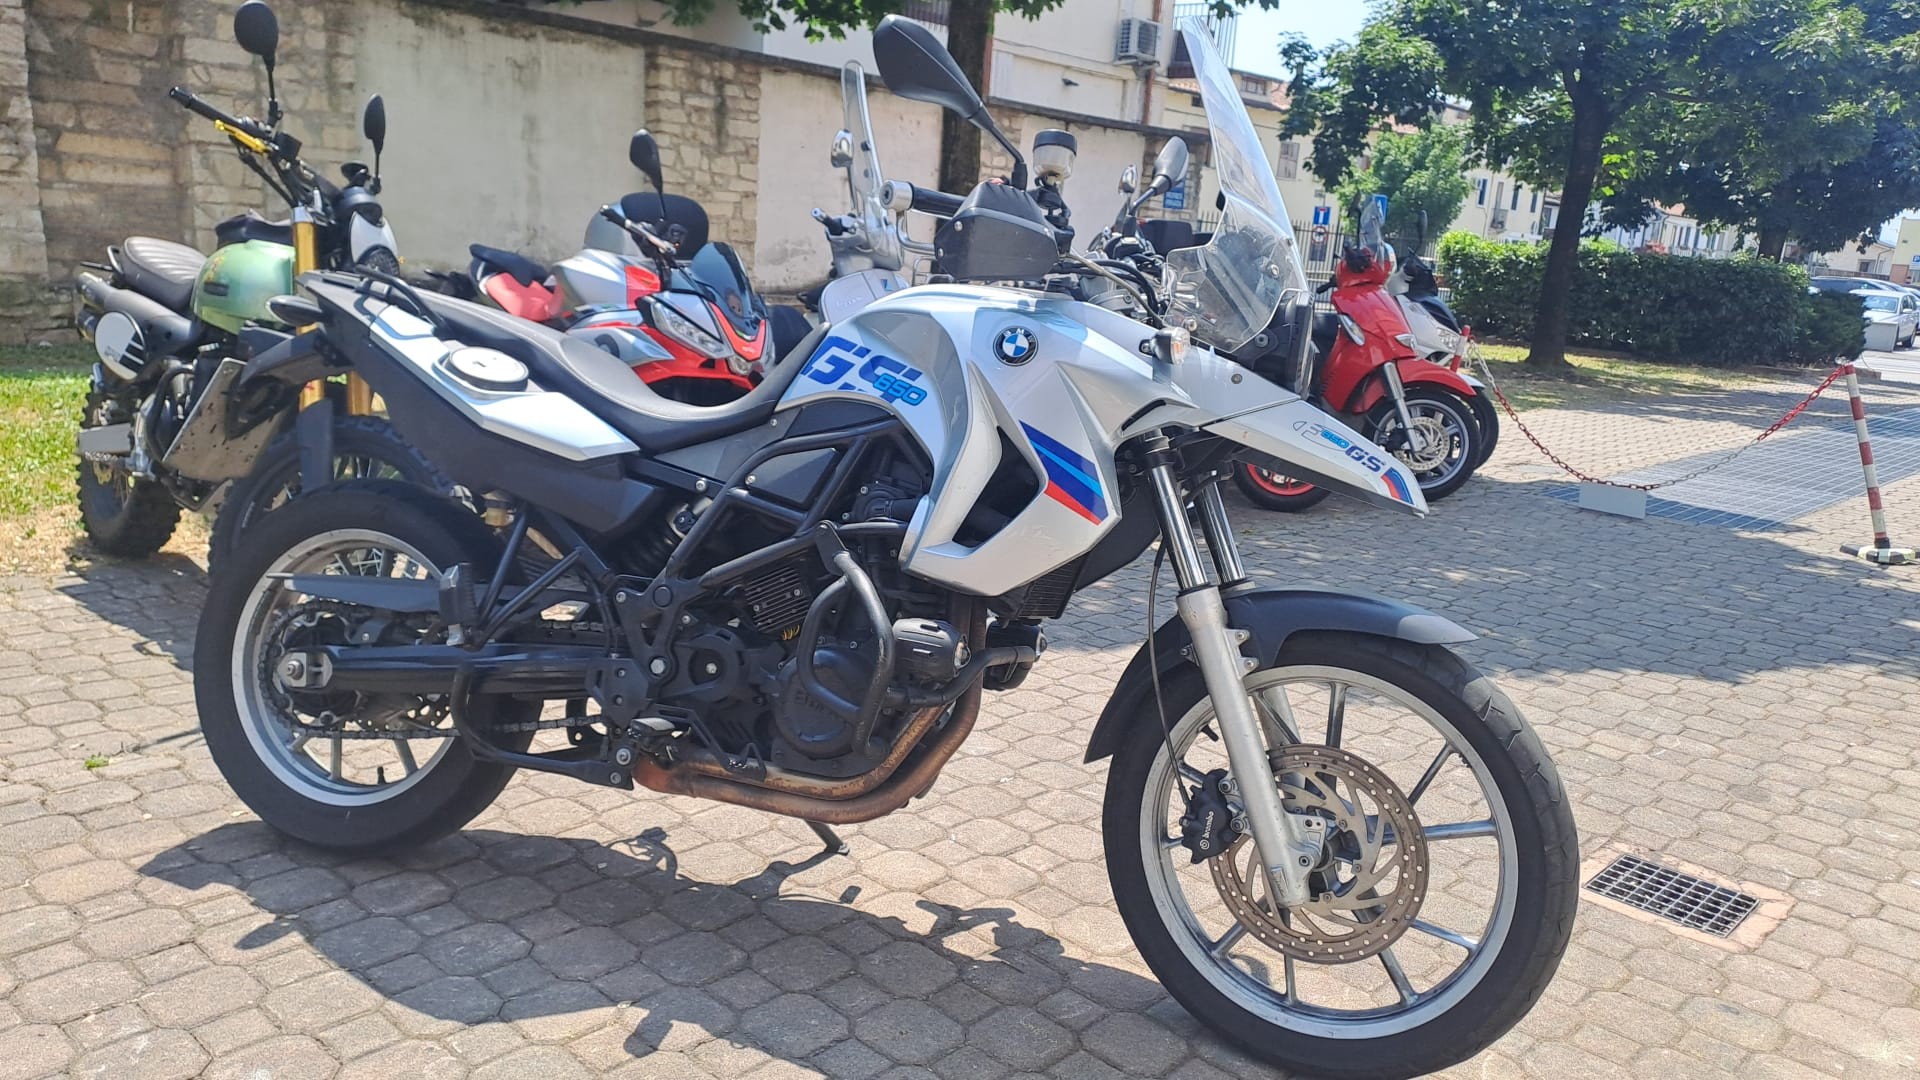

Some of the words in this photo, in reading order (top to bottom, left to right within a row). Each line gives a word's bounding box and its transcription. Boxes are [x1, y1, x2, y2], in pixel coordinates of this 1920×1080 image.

[800, 335, 922, 403] GS
[872, 372, 927, 406] 650
[1320, 428, 1351, 450] 650
[1345, 446, 1387, 473] GS
[1202, 811, 1214, 839] brembo
